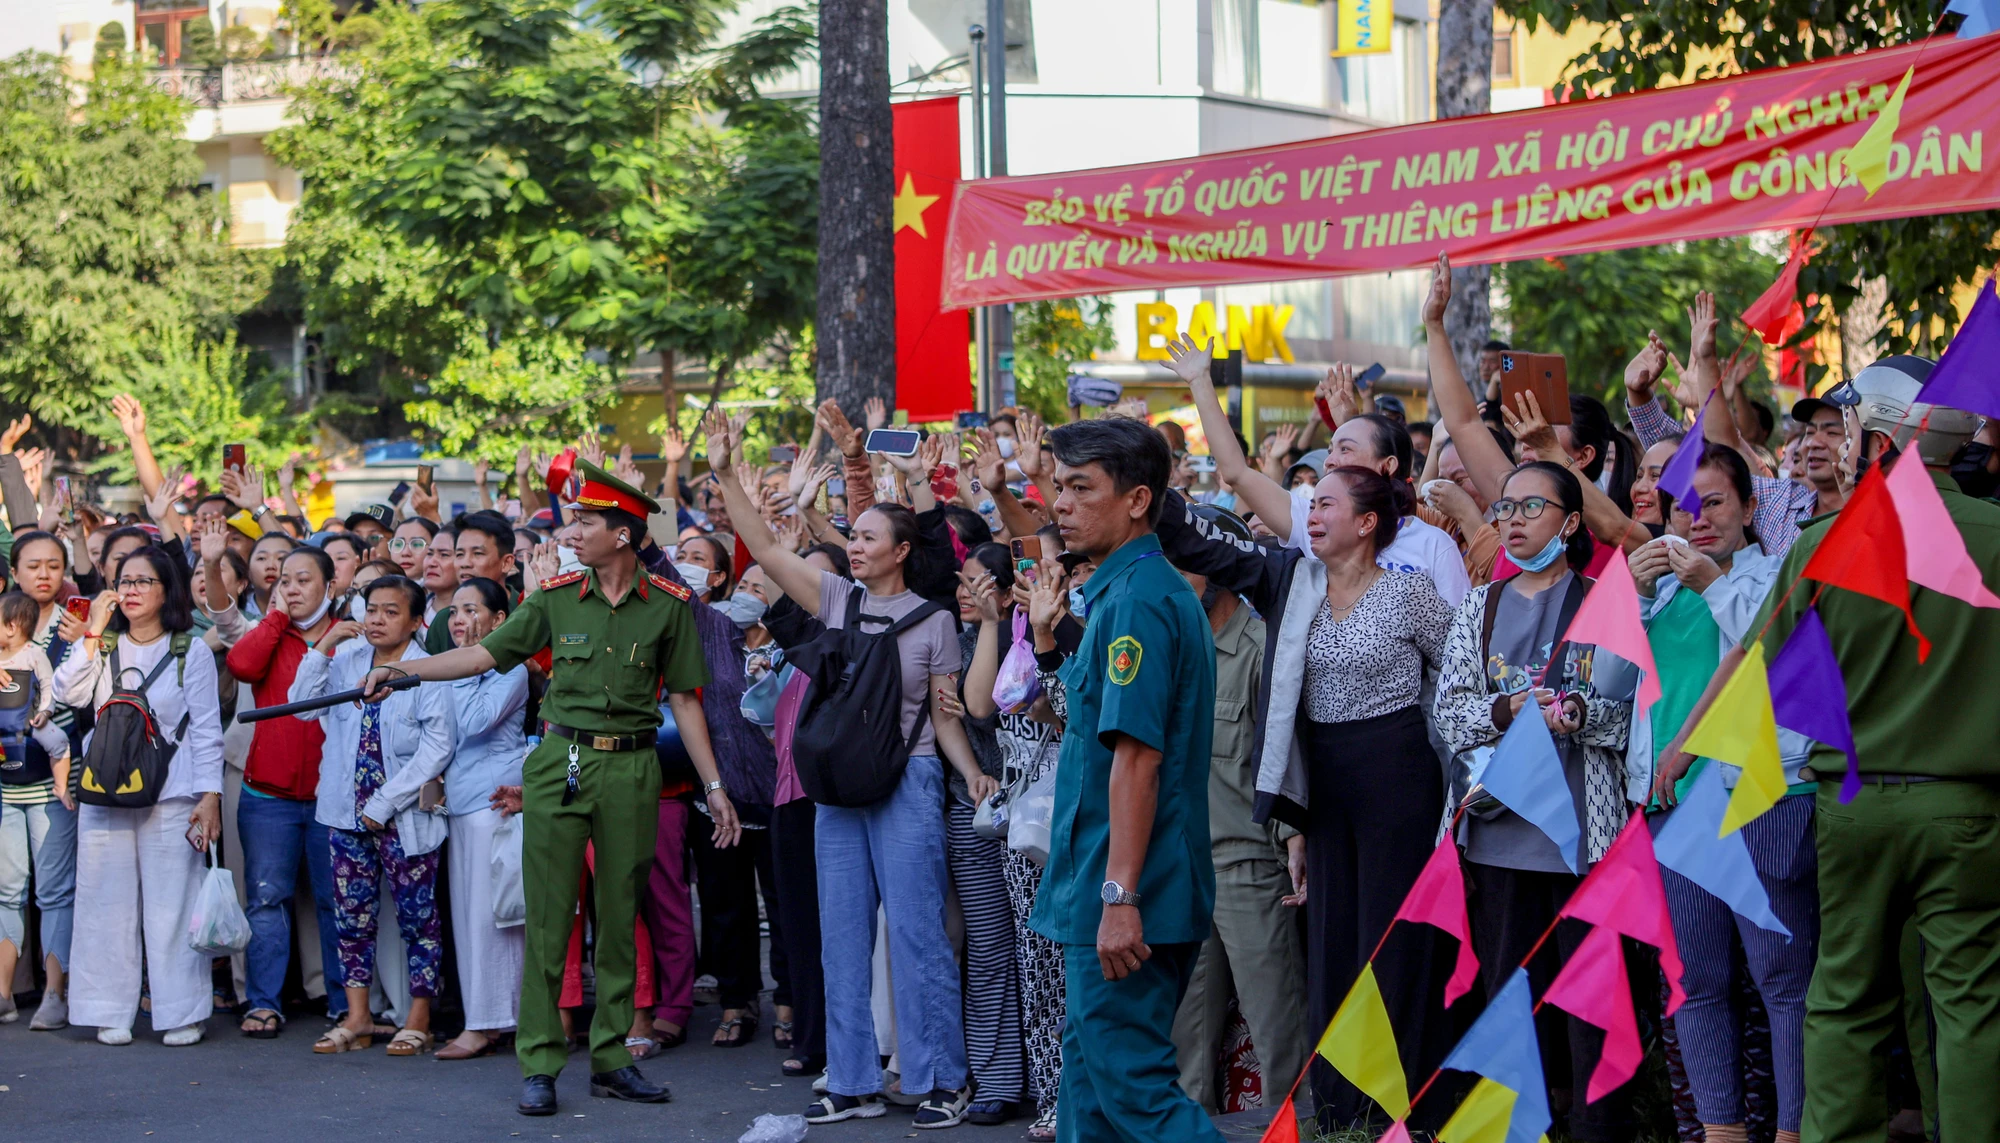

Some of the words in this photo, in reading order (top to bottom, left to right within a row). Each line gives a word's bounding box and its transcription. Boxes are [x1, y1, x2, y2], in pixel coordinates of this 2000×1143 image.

[965, 241, 998, 281] LÀ
[1006, 227, 1112, 278] QUYỀN
[1117, 231, 1159, 265] VÀ
[1168, 222, 1269, 263] NGHĨA
[1282, 219, 1328, 261] VỤ
[1342, 199, 1478, 250] THIÊNG
[1490, 184, 1613, 235] LIÊNG
[1622, 161, 1713, 214] CỦA
[1729, 148, 1859, 202] CÔNG
[1885, 124, 1983, 180] DÂN
[1023, 187, 1085, 227] BẢO
[1095, 183, 1133, 223] VỆ
[1144, 168, 1193, 217] TỔ
[1194, 162, 1288, 216] QUỐC
[1300, 155, 1382, 205] VIỆT
[1392, 147, 1480, 190] NAM
[1488, 131, 1542, 179] XÃ
[1555, 121, 1629, 173] HỘI
[1642, 97, 1733, 156] CHỦ
[1745, 79, 1890, 141] NGHĨA
[1136, 301, 1295, 364] BANK
